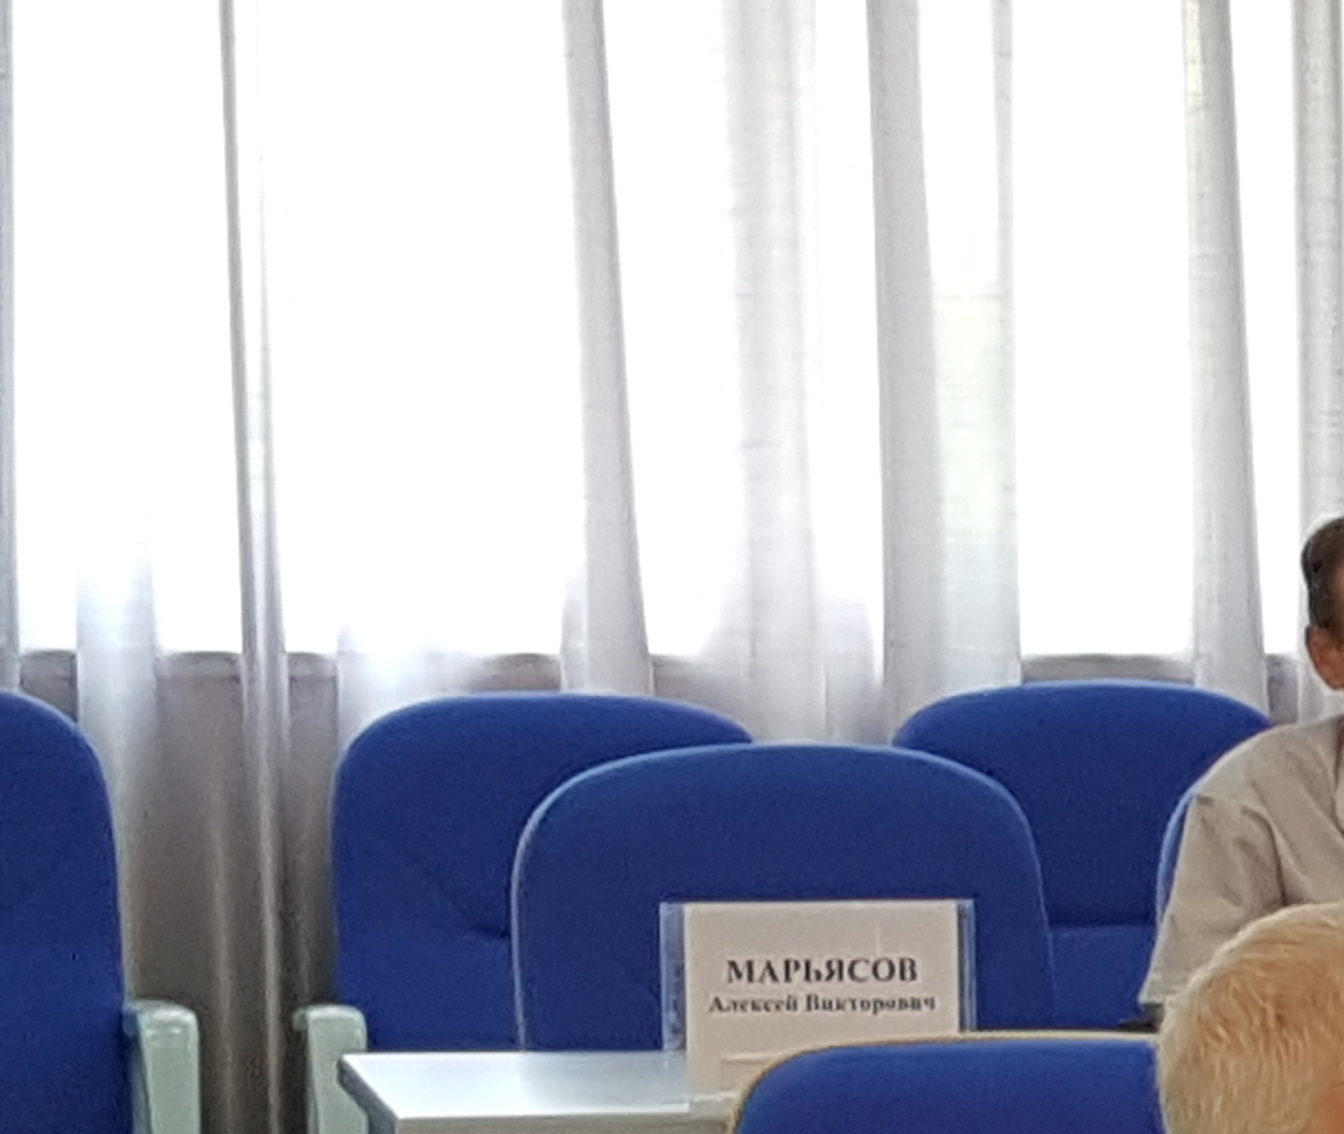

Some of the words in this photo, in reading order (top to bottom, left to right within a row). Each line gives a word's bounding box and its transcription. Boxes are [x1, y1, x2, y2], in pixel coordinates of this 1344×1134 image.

[727, 957, 918, 984] МАРЬЯСОВ
[708, 994, 798, 1013] Алексей
[806, 993, 936, 1016] Викторович
